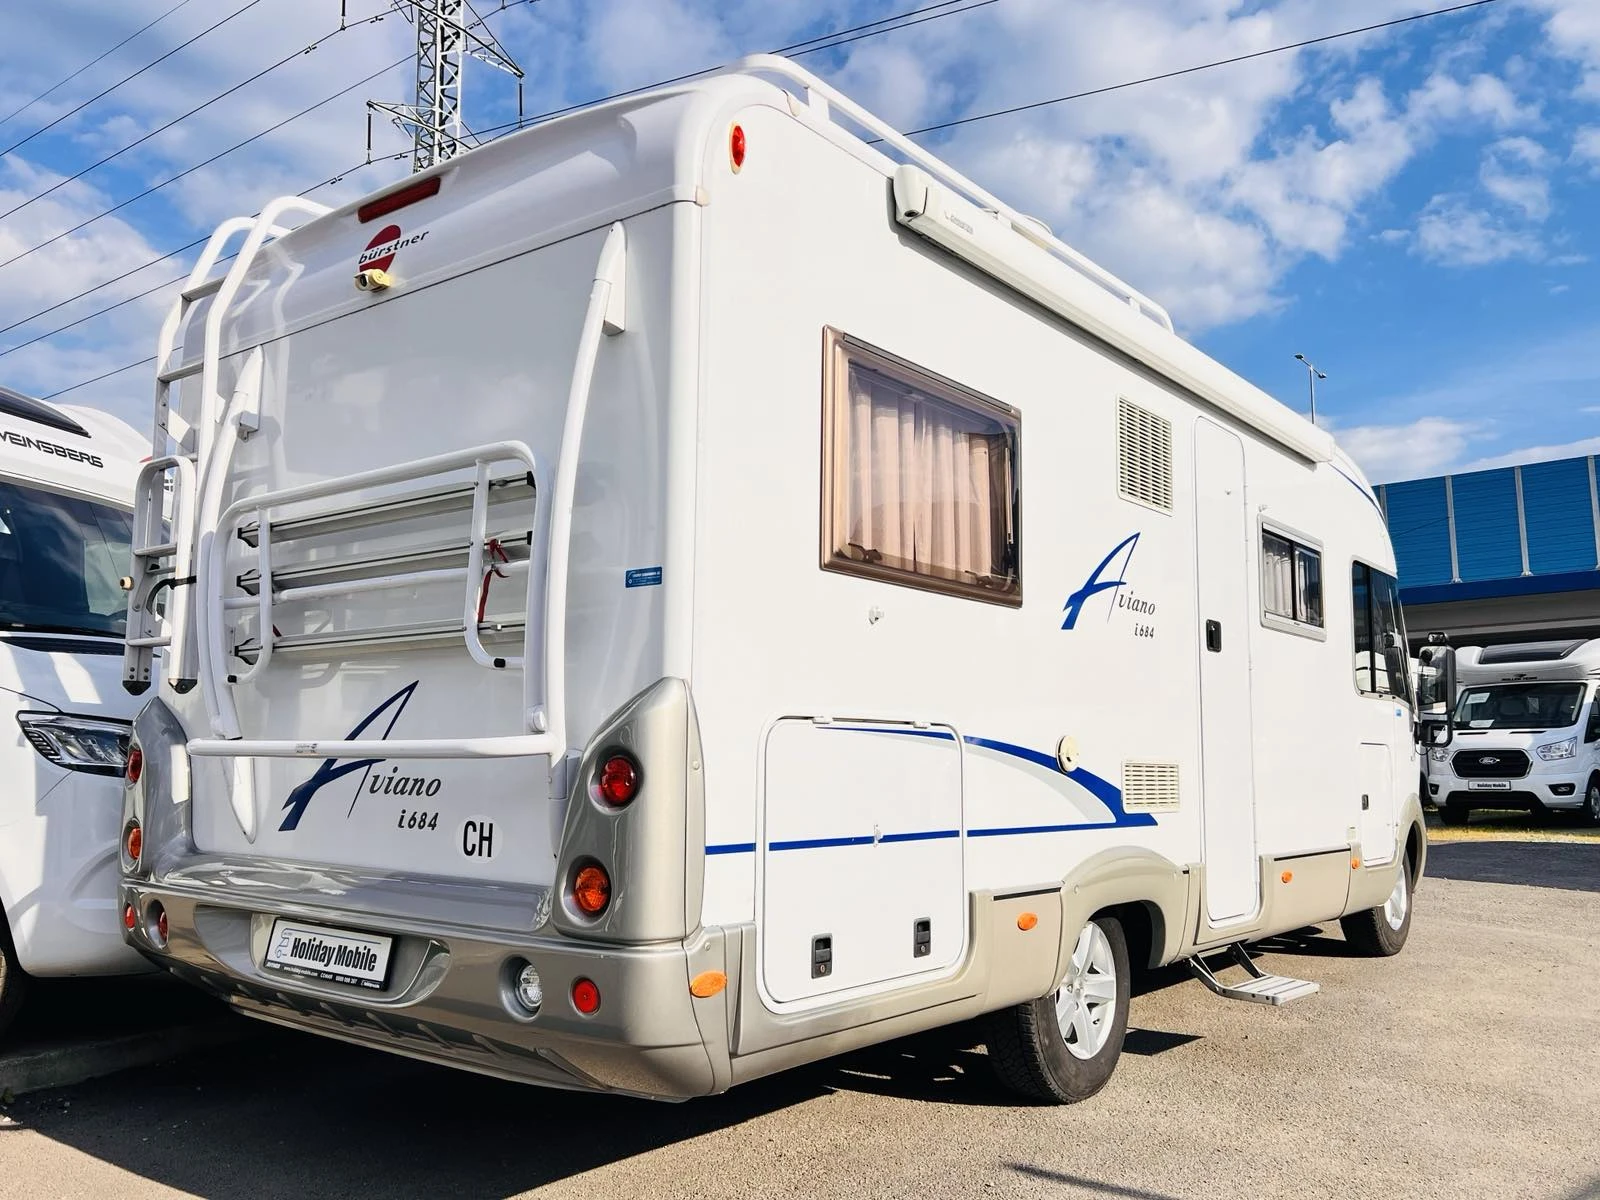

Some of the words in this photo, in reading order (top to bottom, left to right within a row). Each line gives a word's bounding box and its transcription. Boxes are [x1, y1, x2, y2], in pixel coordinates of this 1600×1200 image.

[358, 230, 430, 265] bürstner
[1061, 531, 1156, 630] Aviano
[278, 679, 442, 832] Aviano
[397, 808, 439, 831] i684
[462, 820, 494, 858] CH
[290, 937, 337, 967] Holiday
[333, 944, 378, 972] Mobile
